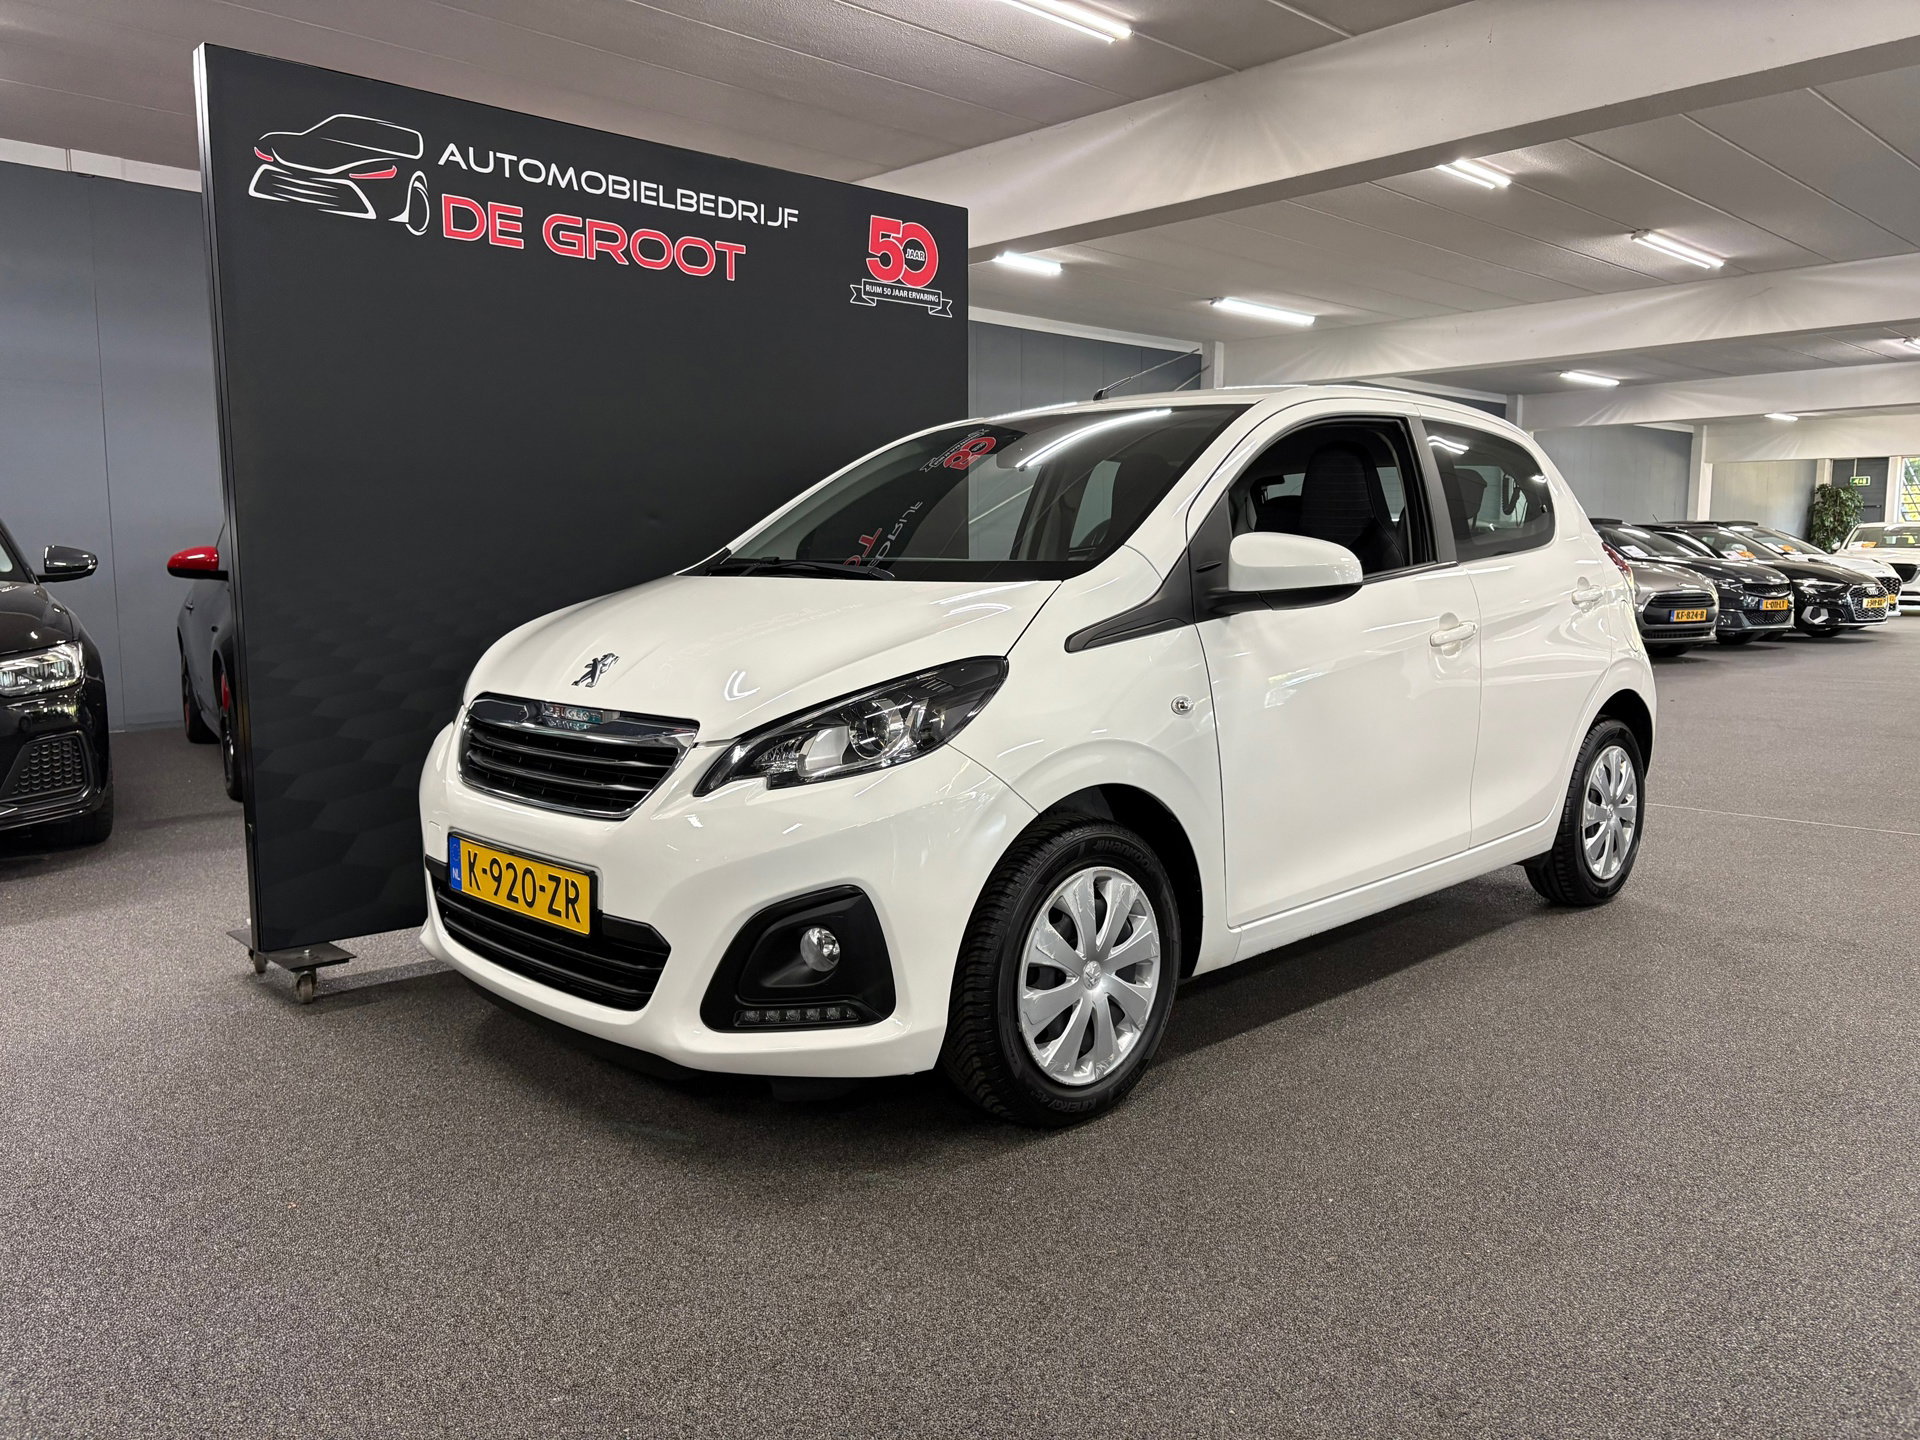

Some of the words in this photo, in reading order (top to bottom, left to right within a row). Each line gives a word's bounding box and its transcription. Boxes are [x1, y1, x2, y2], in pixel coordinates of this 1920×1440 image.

[437, 142, 799, 229] AUTOMOBIELBEDRIJF
[441, 193, 525, 250] DE
[542, 213, 747, 281] GROOT
[866, 214, 939, 288] 50
[906, 248, 925, 261] JAAR
[865, 284, 882, 294] RUIM
[883, 287, 892, 295] 50
[892, 289, 908, 298] JAAR
[908, 291, 939, 302] ERVARING
[452, 867, 461, 881] NL
[467, 849, 581, 923] K-920-ZR
